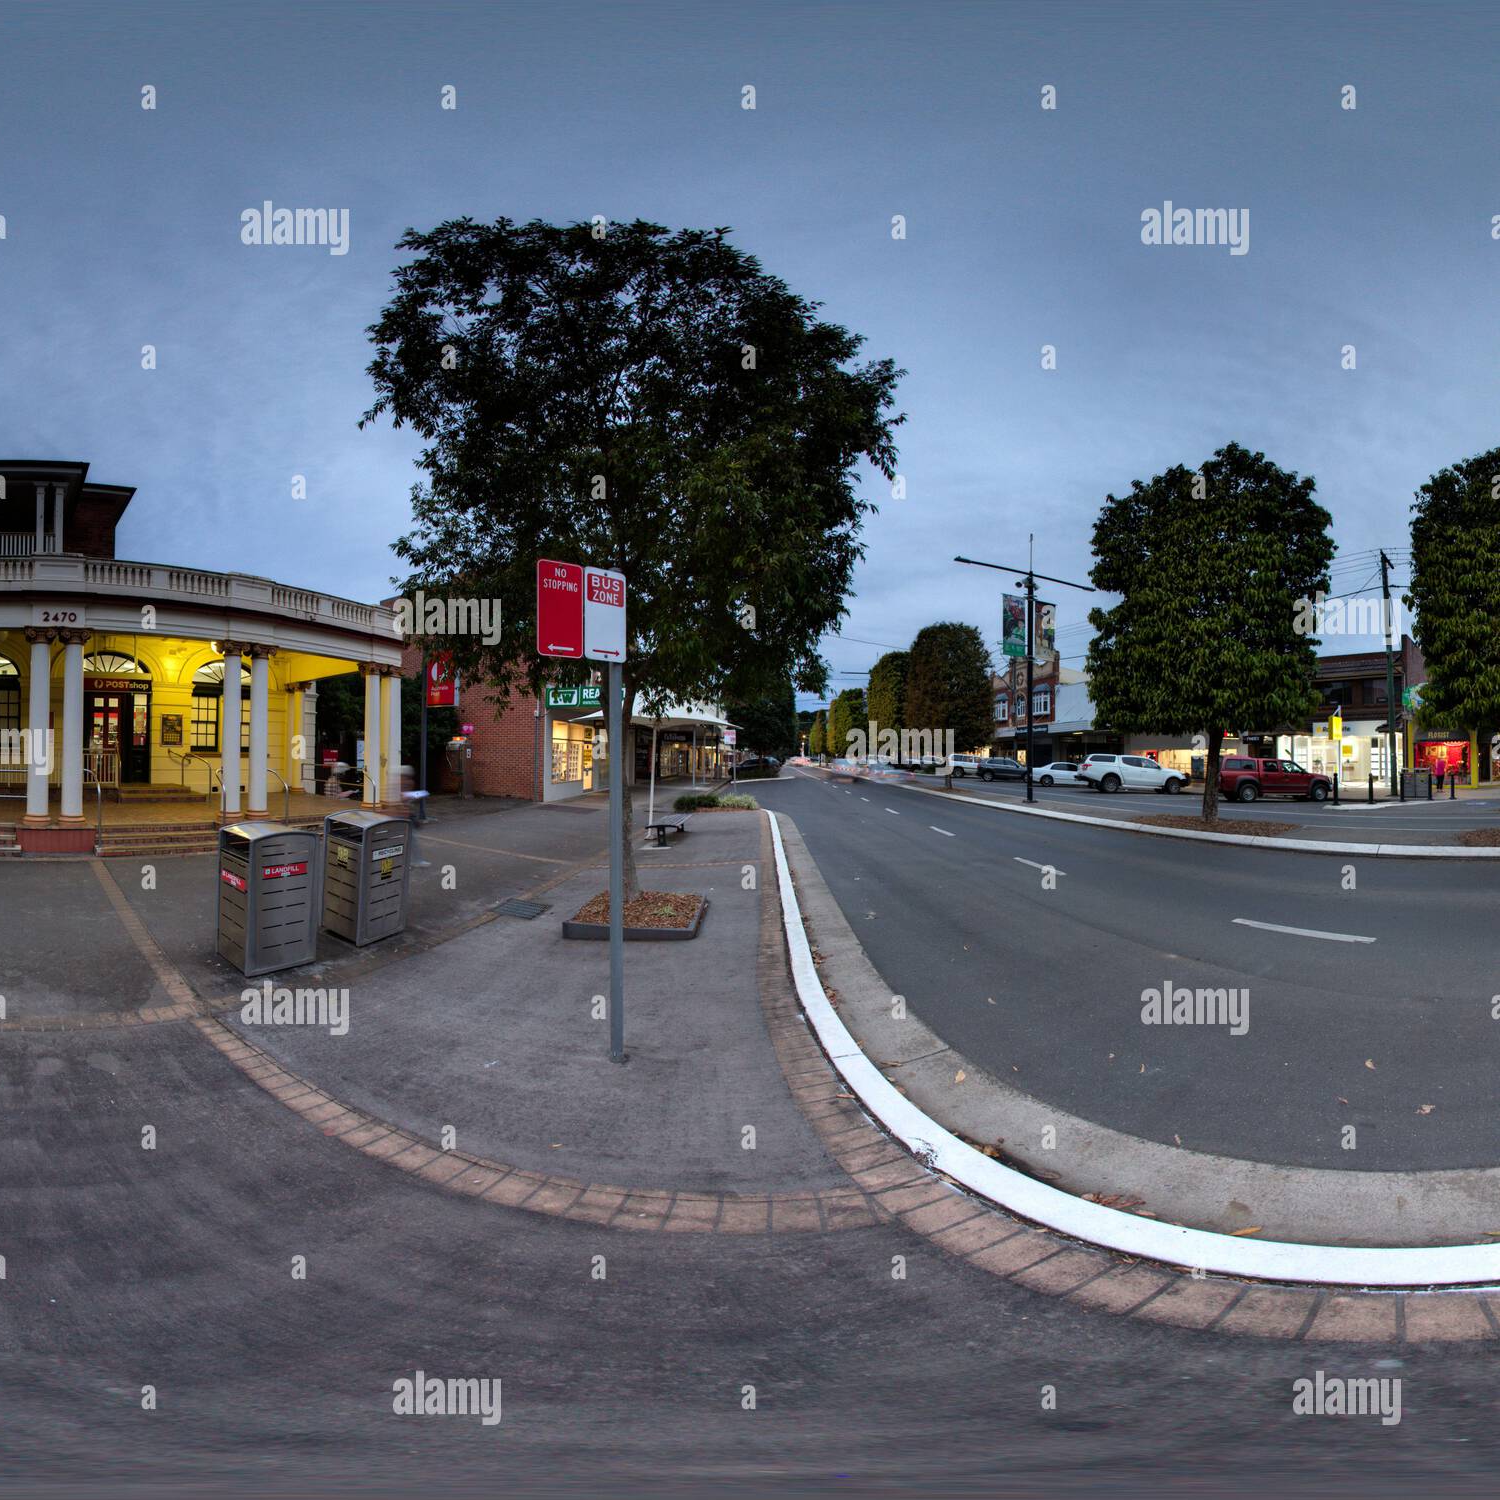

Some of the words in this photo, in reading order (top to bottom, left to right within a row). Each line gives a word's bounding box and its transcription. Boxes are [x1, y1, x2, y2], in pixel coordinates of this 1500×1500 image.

[554, 567, 567, 578] NO
[543, 578, 578, 593] STOPPING
[591, 575, 620, 592] BUS
[592, 589, 619, 605] ZONE
[42, 611, 77, 623] 2470
[105, 680, 149, 690] POSTshop
[582, 688, 600, 699] REA
[271, 866, 299, 874] LANDFILL
